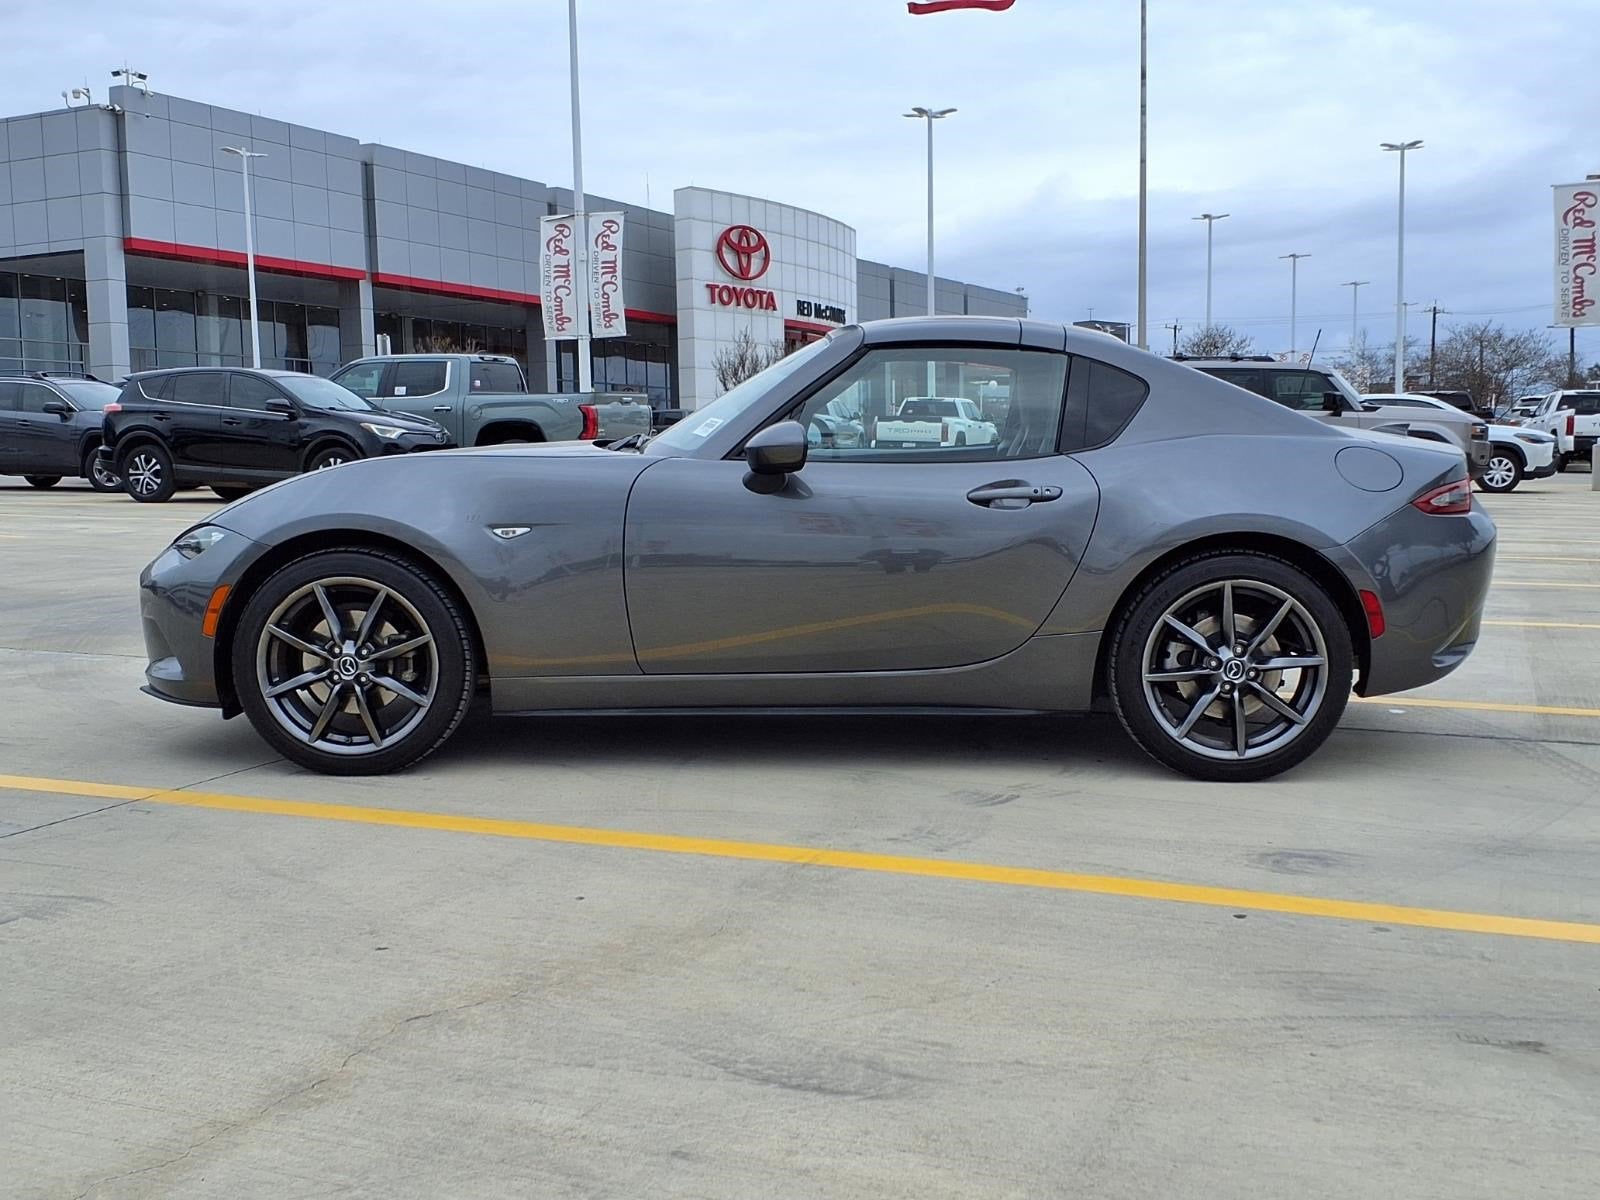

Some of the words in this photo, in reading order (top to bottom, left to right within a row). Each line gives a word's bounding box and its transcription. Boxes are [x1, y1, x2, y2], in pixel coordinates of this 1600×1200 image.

[1562, 191, 1598, 229] Red
[546, 223, 571, 256] Red
[594, 219, 620, 252] Red
[1561, 228, 1569, 266] DRIVEN
[544, 254, 552, 287] DRIVEN
[1561, 270, 1569, 285] TO
[1572, 230, 1597, 318] McCombs
[545, 290, 552, 302] TO
[553, 258, 572, 332] McCombs
[594, 287, 600, 299] TO
[601, 254, 620, 329] McCombs
[706, 284, 778, 311] TOYOTA
[796, 299, 813, 317] RED
[1561, 287, 1569, 318] SERVE
[546, 304, 555, 332] SERVE
